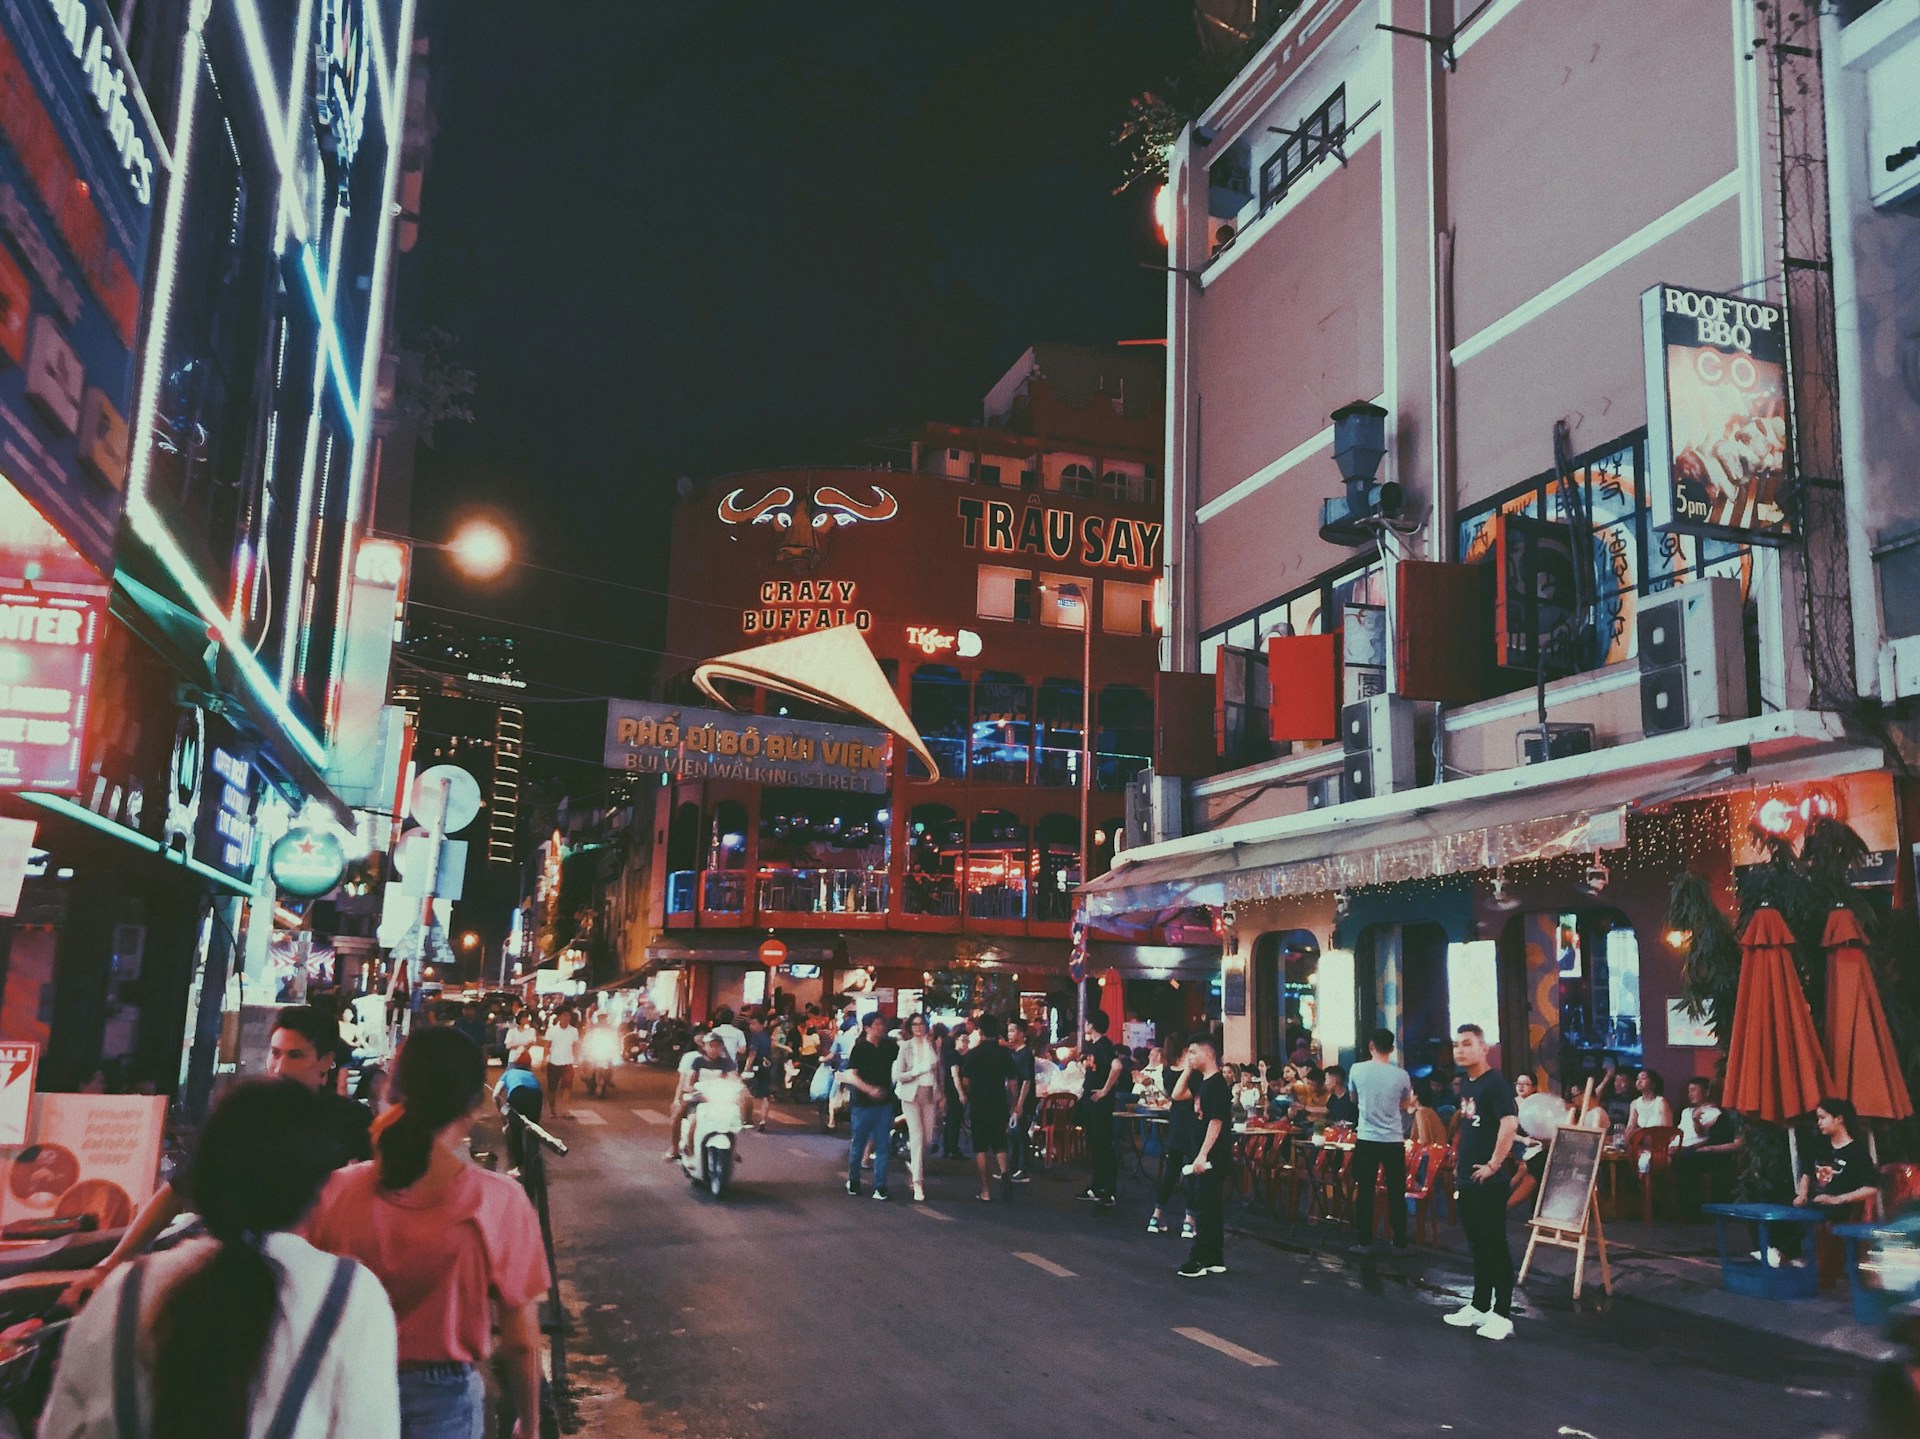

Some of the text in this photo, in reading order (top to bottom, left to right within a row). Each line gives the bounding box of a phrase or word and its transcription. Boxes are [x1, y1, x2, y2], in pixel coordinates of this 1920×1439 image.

[1664, 287, 1779, 331] ROOFTOP
[1697, 317, 1752, 354] BBQ
[1676, 484, 1708, 517] 5pm
[957, 493, 1163, 569] TRÂU SAY
[760, 580, 856, 604] CRAZY
[742, 608, 872, 632] BUFFALO
[906, 626, 955, 654] Tiger
[664, 757, 708, 776] VIEN
[713, 760, 798, 785] WALKING
[801, 772, 871, 791] STREET
[1471, 1114, 1481, 1127] 2
